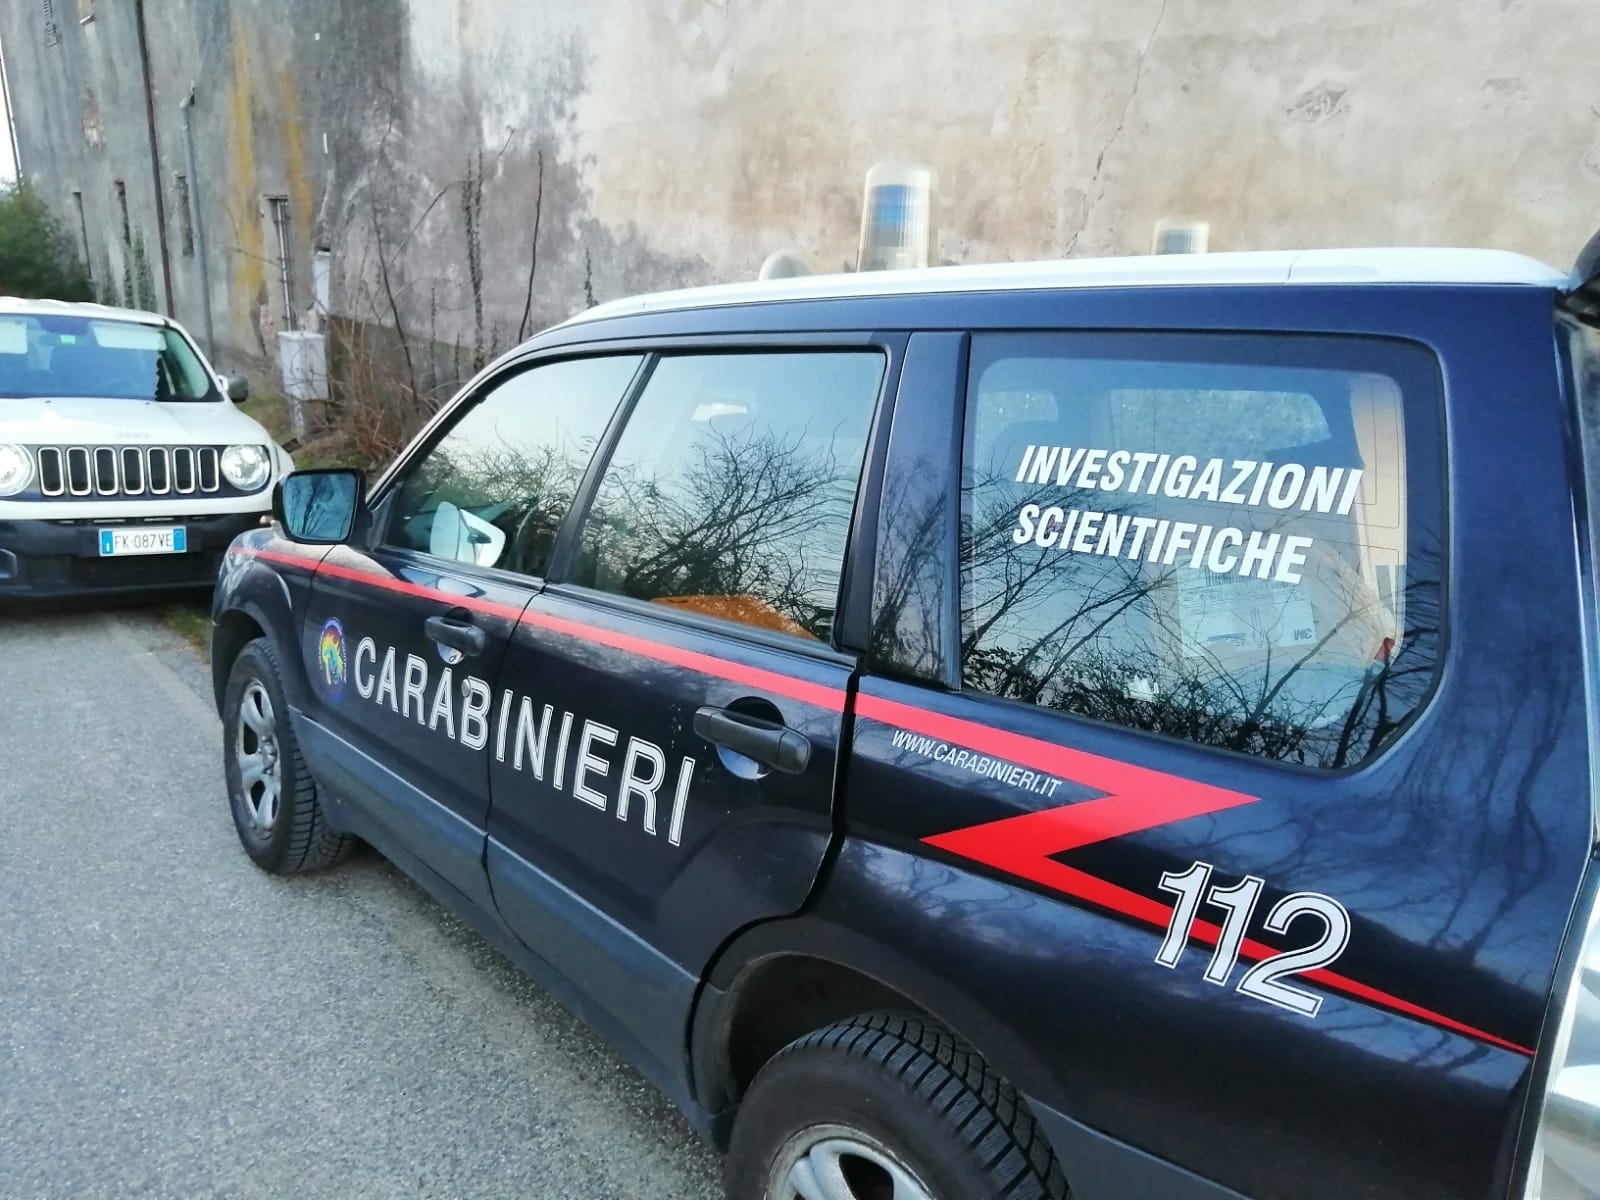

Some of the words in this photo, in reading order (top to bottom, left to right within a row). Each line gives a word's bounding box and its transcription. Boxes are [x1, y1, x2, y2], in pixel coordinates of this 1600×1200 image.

[1015, 444, 1364, 516] INVESTIGAZIONI
[1012, 503, 1313, 585] SCIENTIFICHE
[354, 636, 697, 848] CARABINIERI
[891, 729, 1063, 798] WWW.CARABINIERI.IT
[1154, 860, 1351, 1019] 112
